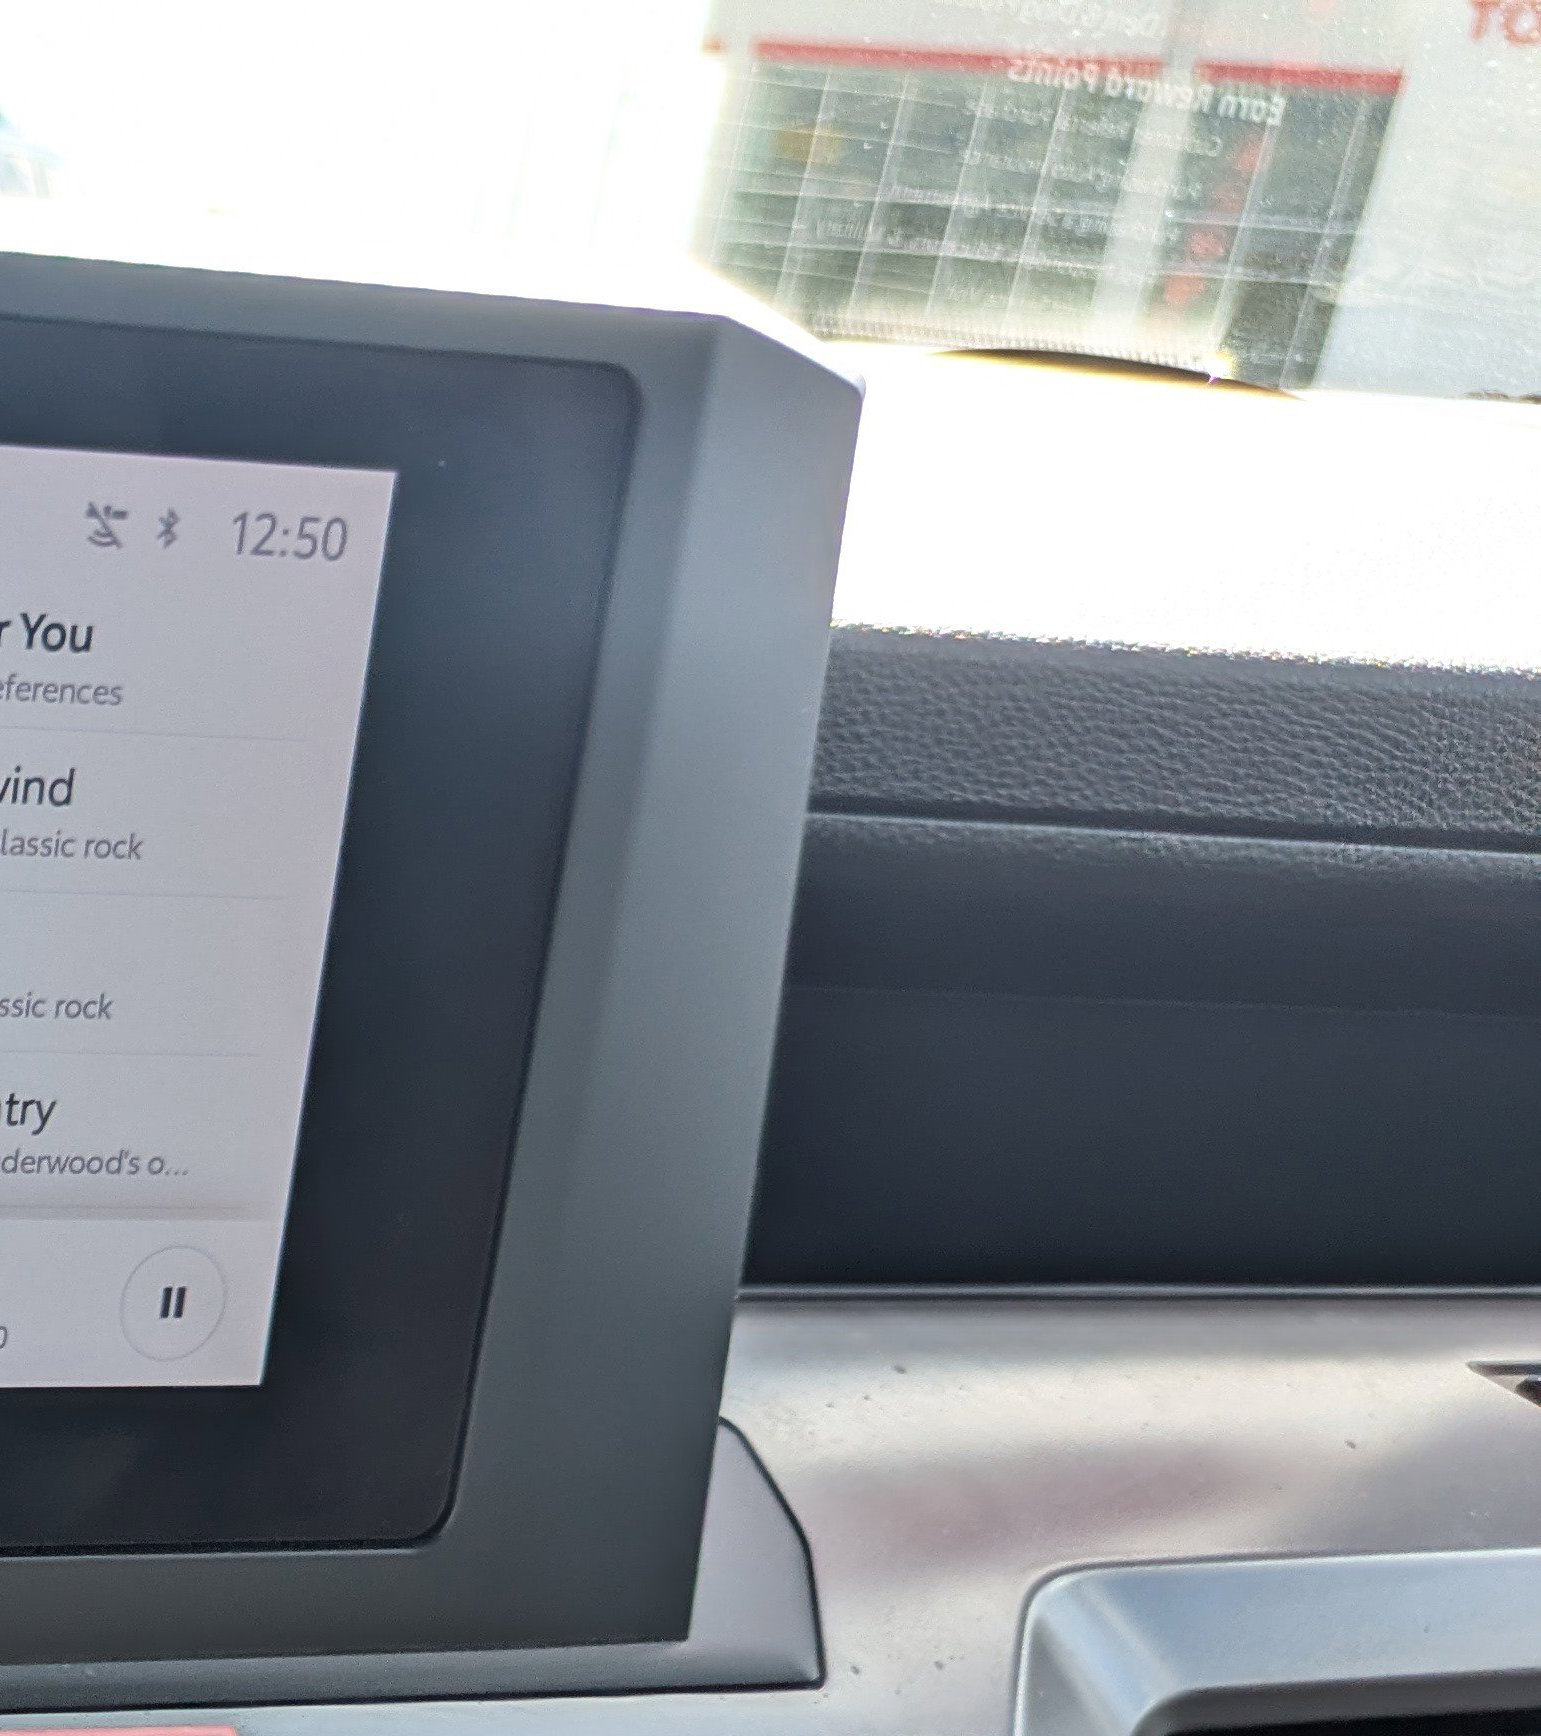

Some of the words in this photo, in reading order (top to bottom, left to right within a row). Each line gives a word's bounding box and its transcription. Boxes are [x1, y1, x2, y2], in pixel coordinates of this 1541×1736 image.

[231, 511, 349, 562] 12:50
[20, 613, 95, 653] You
[84, 830, 143, 862] rock
[54, 993, 113, 1021] rock
